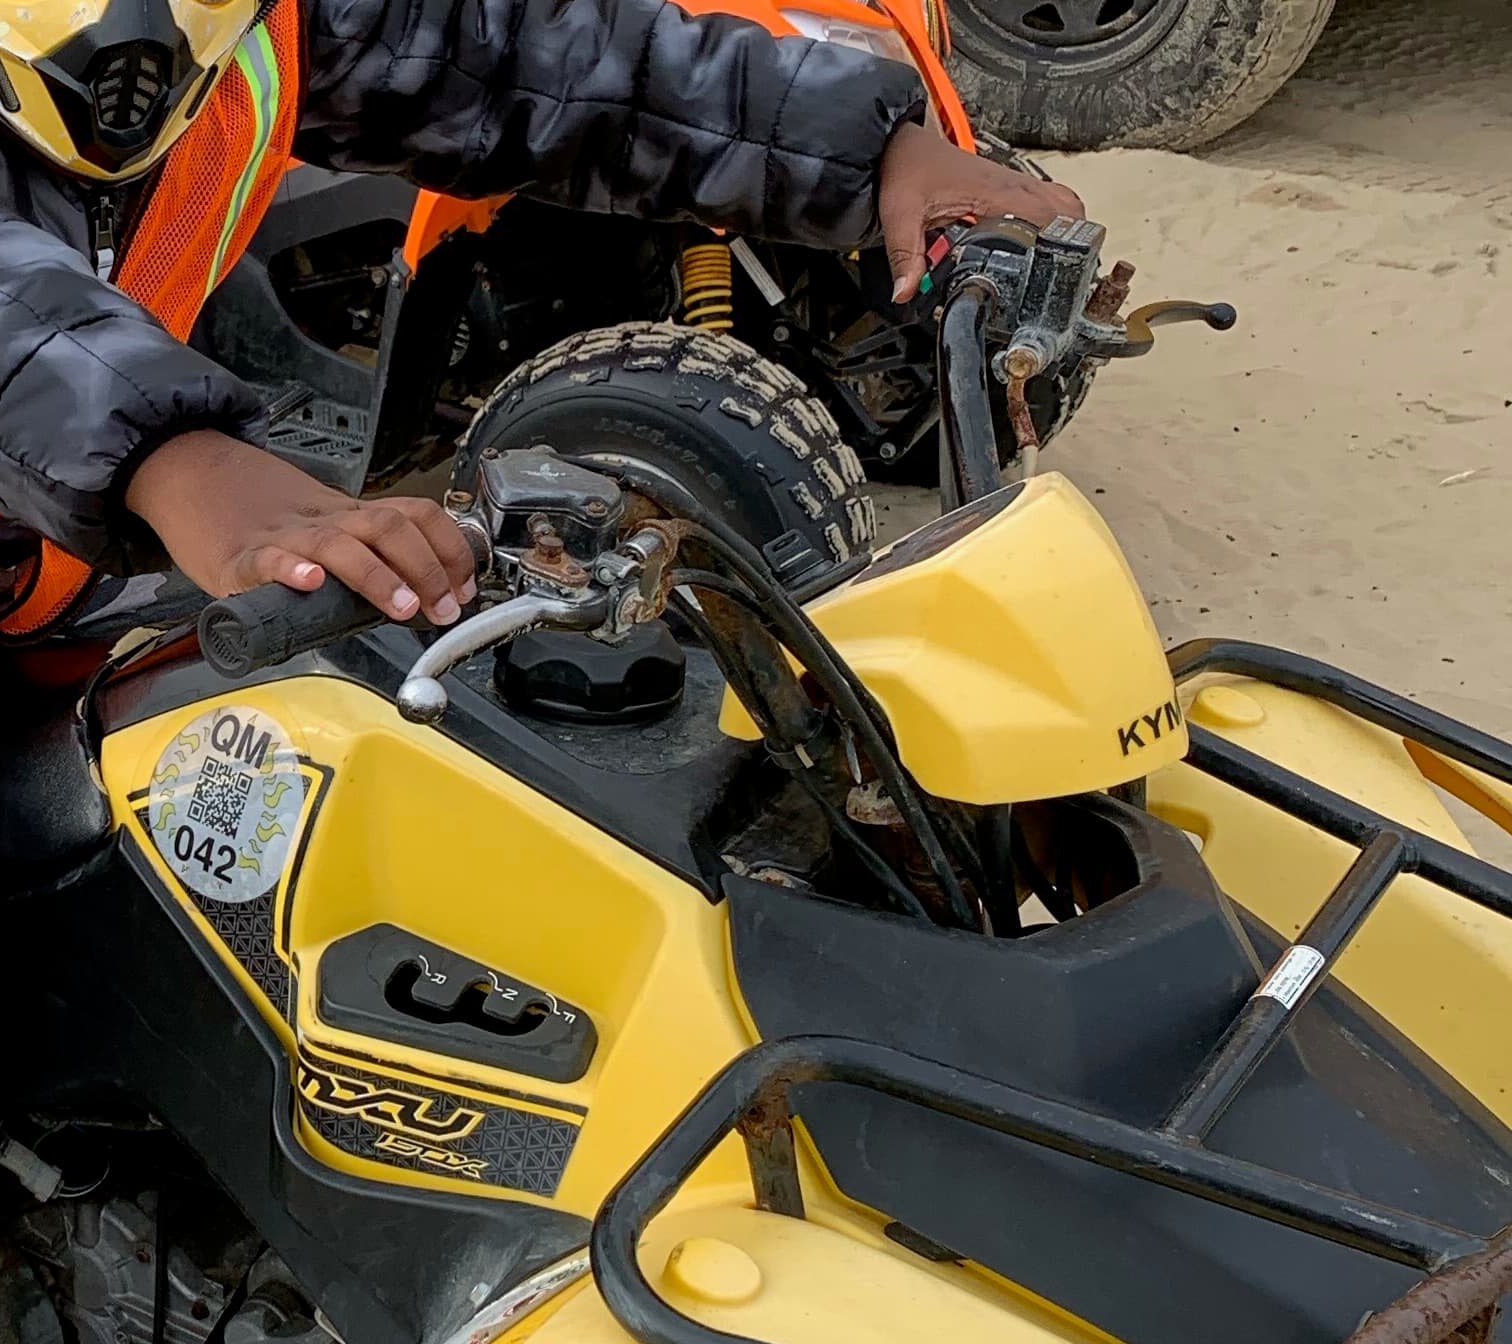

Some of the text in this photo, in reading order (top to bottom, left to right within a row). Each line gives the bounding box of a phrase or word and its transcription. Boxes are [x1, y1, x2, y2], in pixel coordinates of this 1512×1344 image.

[211, 714, 272, 770] QM
[174, 824, 237, 884] 042
[430, 972, 447, 985] R
[501, 988, 519, 1001] N
[562, 1011, 577, 1025] F
